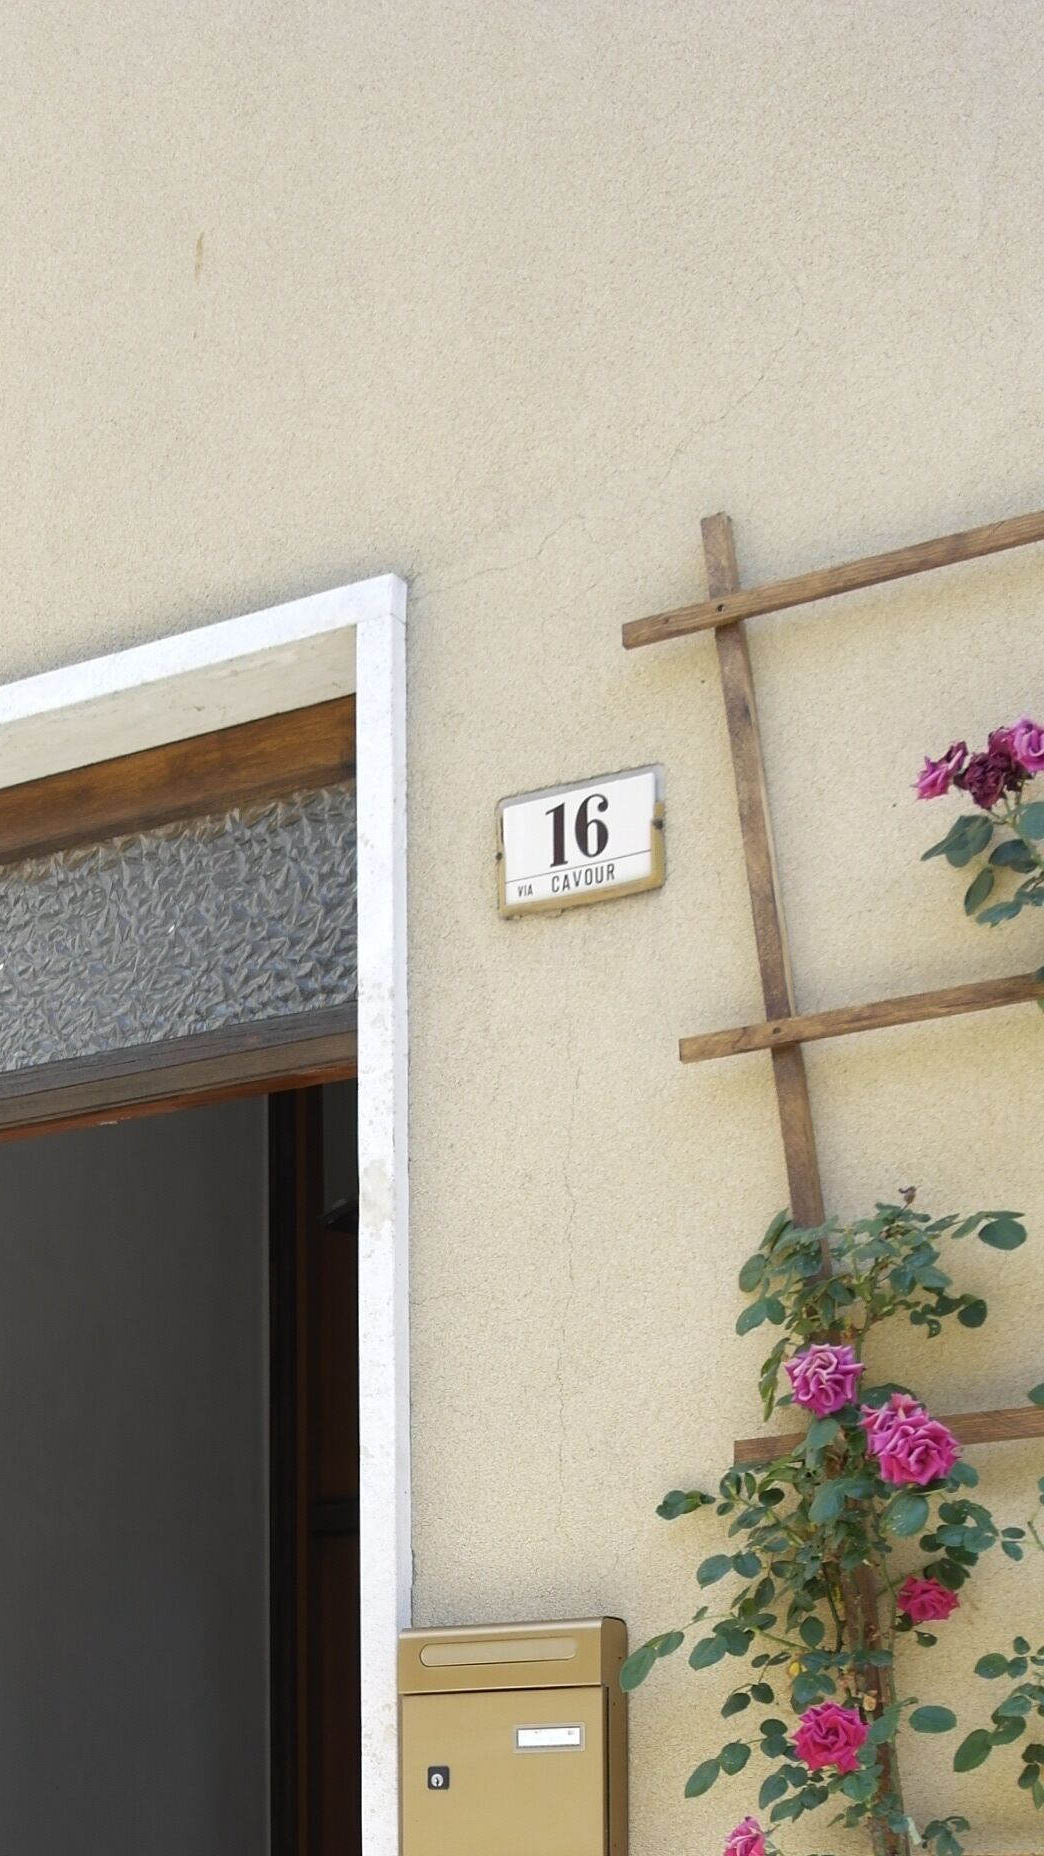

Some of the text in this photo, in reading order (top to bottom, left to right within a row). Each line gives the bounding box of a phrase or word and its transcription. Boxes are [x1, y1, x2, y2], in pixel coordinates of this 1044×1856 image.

[545, 793, 609, 868] 16
[517, 863, 616, 898] VIA CAVOUR
